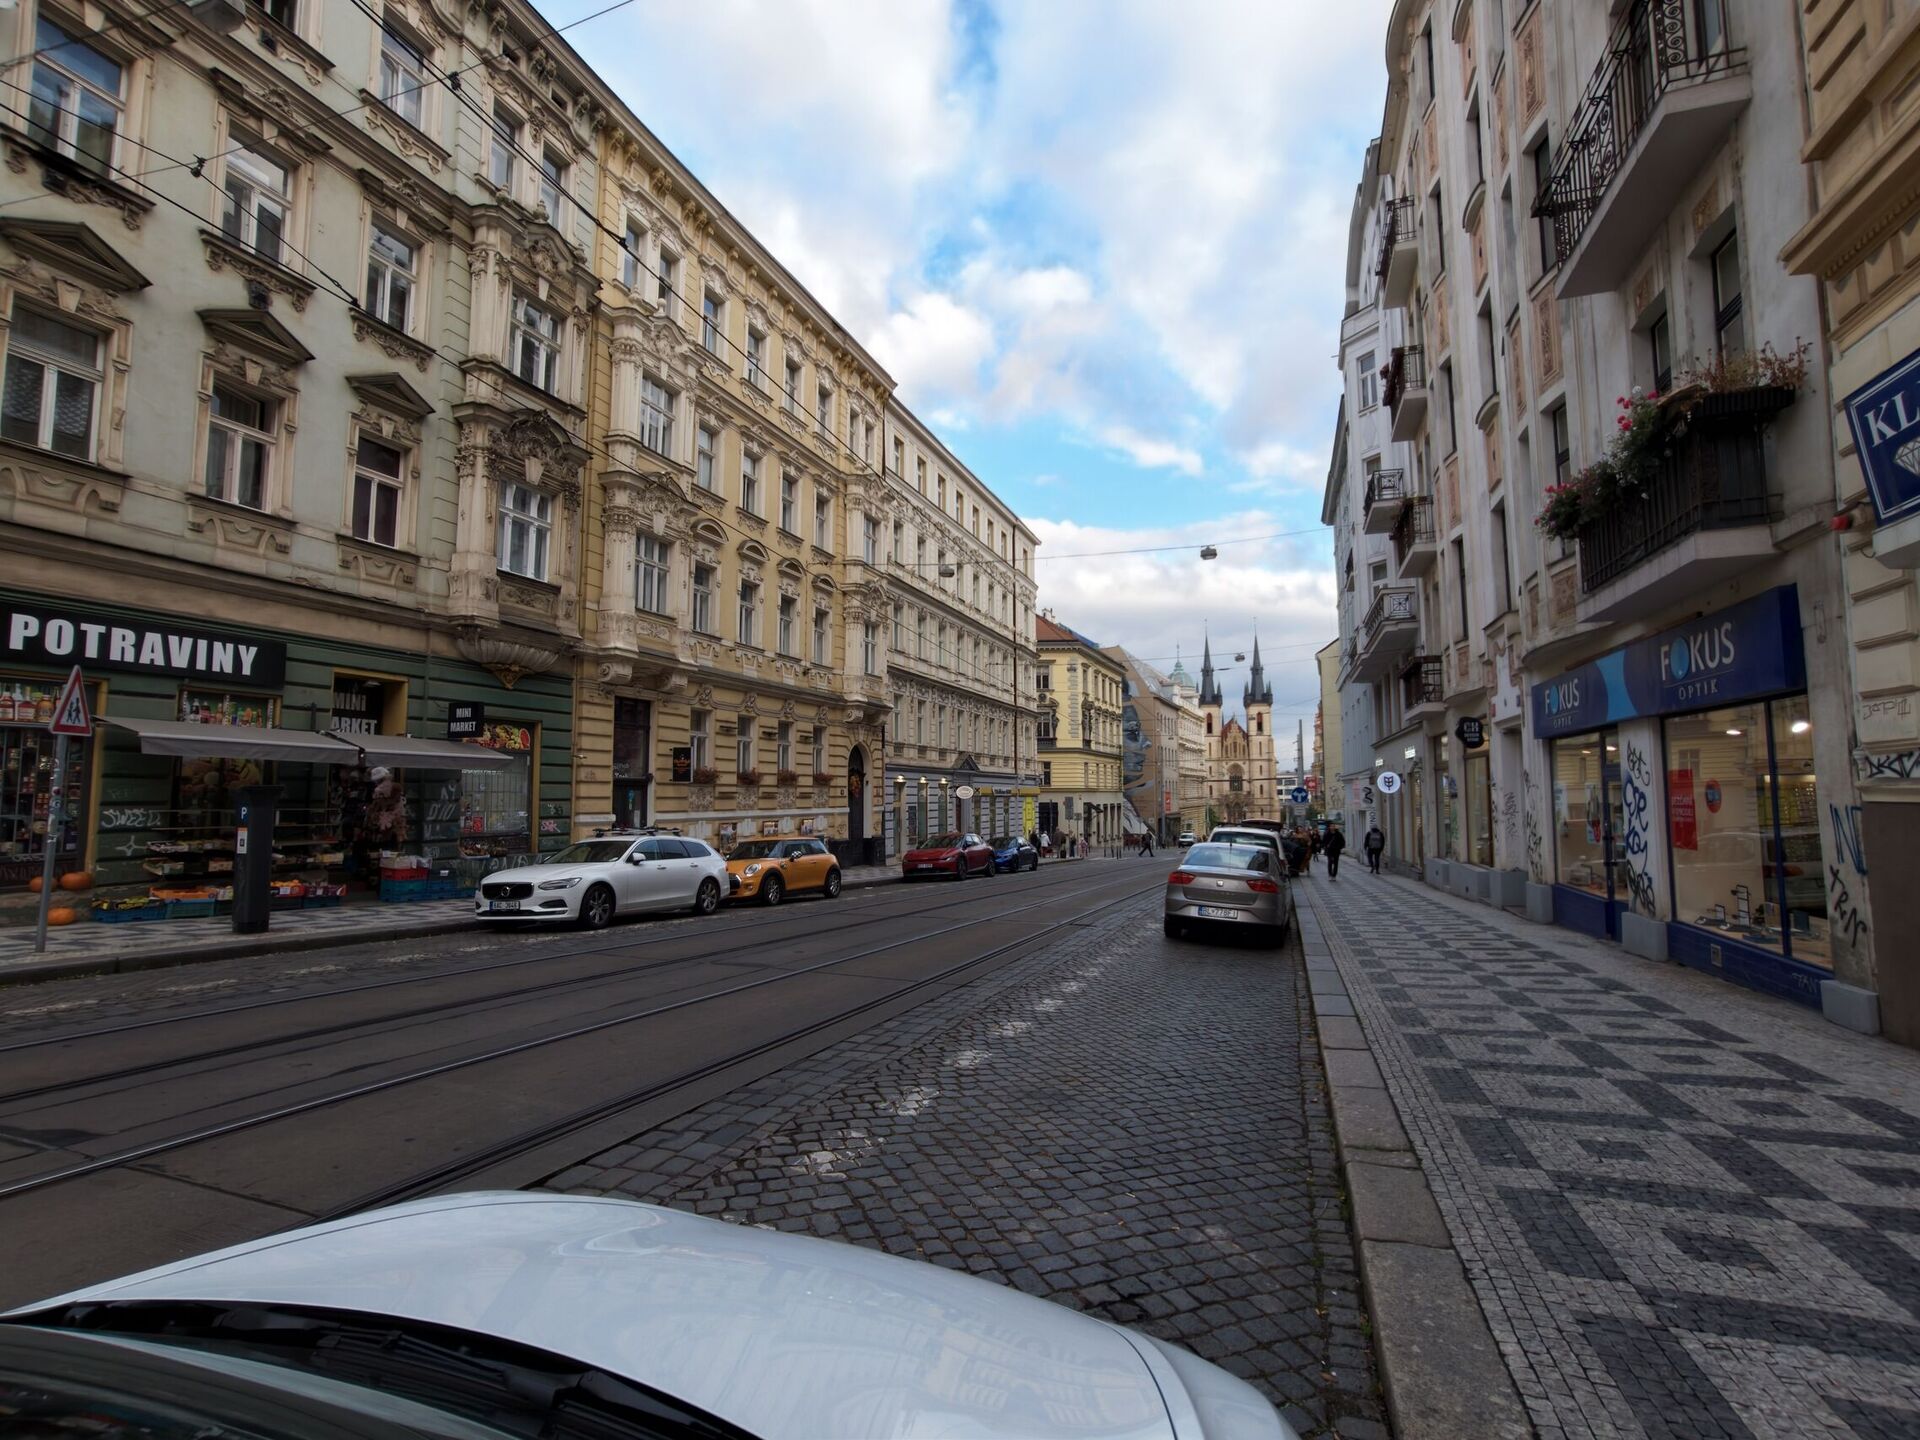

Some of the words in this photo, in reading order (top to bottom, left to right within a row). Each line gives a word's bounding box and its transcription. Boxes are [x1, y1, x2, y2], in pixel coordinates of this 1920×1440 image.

[1864, 380, 1920, 448] KL
[9, 613, 259, 677] POTRAVINY
[1660, 621, 1736, 681] FOKUS
[1544, 677, 1580, 715] FOKUS
[1678, 679, 1719, 701] OPTIK
[331, 715, 378, 736] ARKET
[450, 720, 477, 733] MARKET
[455, 707, 472, 719] MINI
